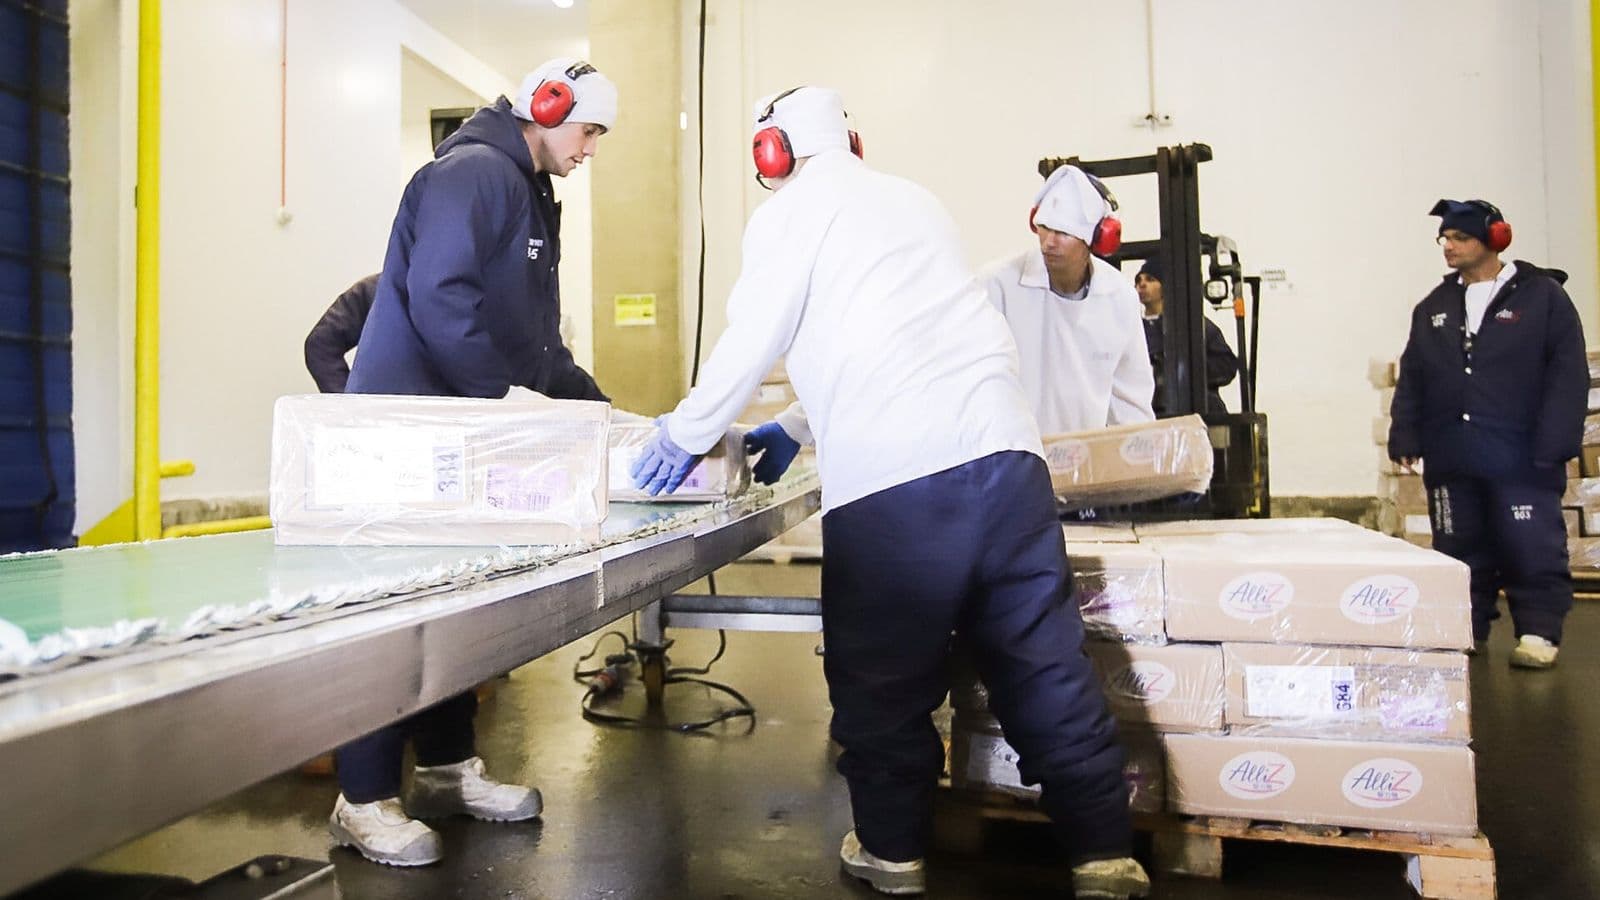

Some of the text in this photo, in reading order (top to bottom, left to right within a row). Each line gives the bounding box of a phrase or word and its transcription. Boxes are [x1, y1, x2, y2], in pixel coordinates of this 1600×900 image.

[1228, 580, 1285, 604] AlliZ
[1350, 583, 1409, 608] AlliZ
[1108, 669, 1164, 693] AlliZ
[1228, 760, 1286, 785] AlliZ
[1350, 768, 1412, 794] AlliZ
